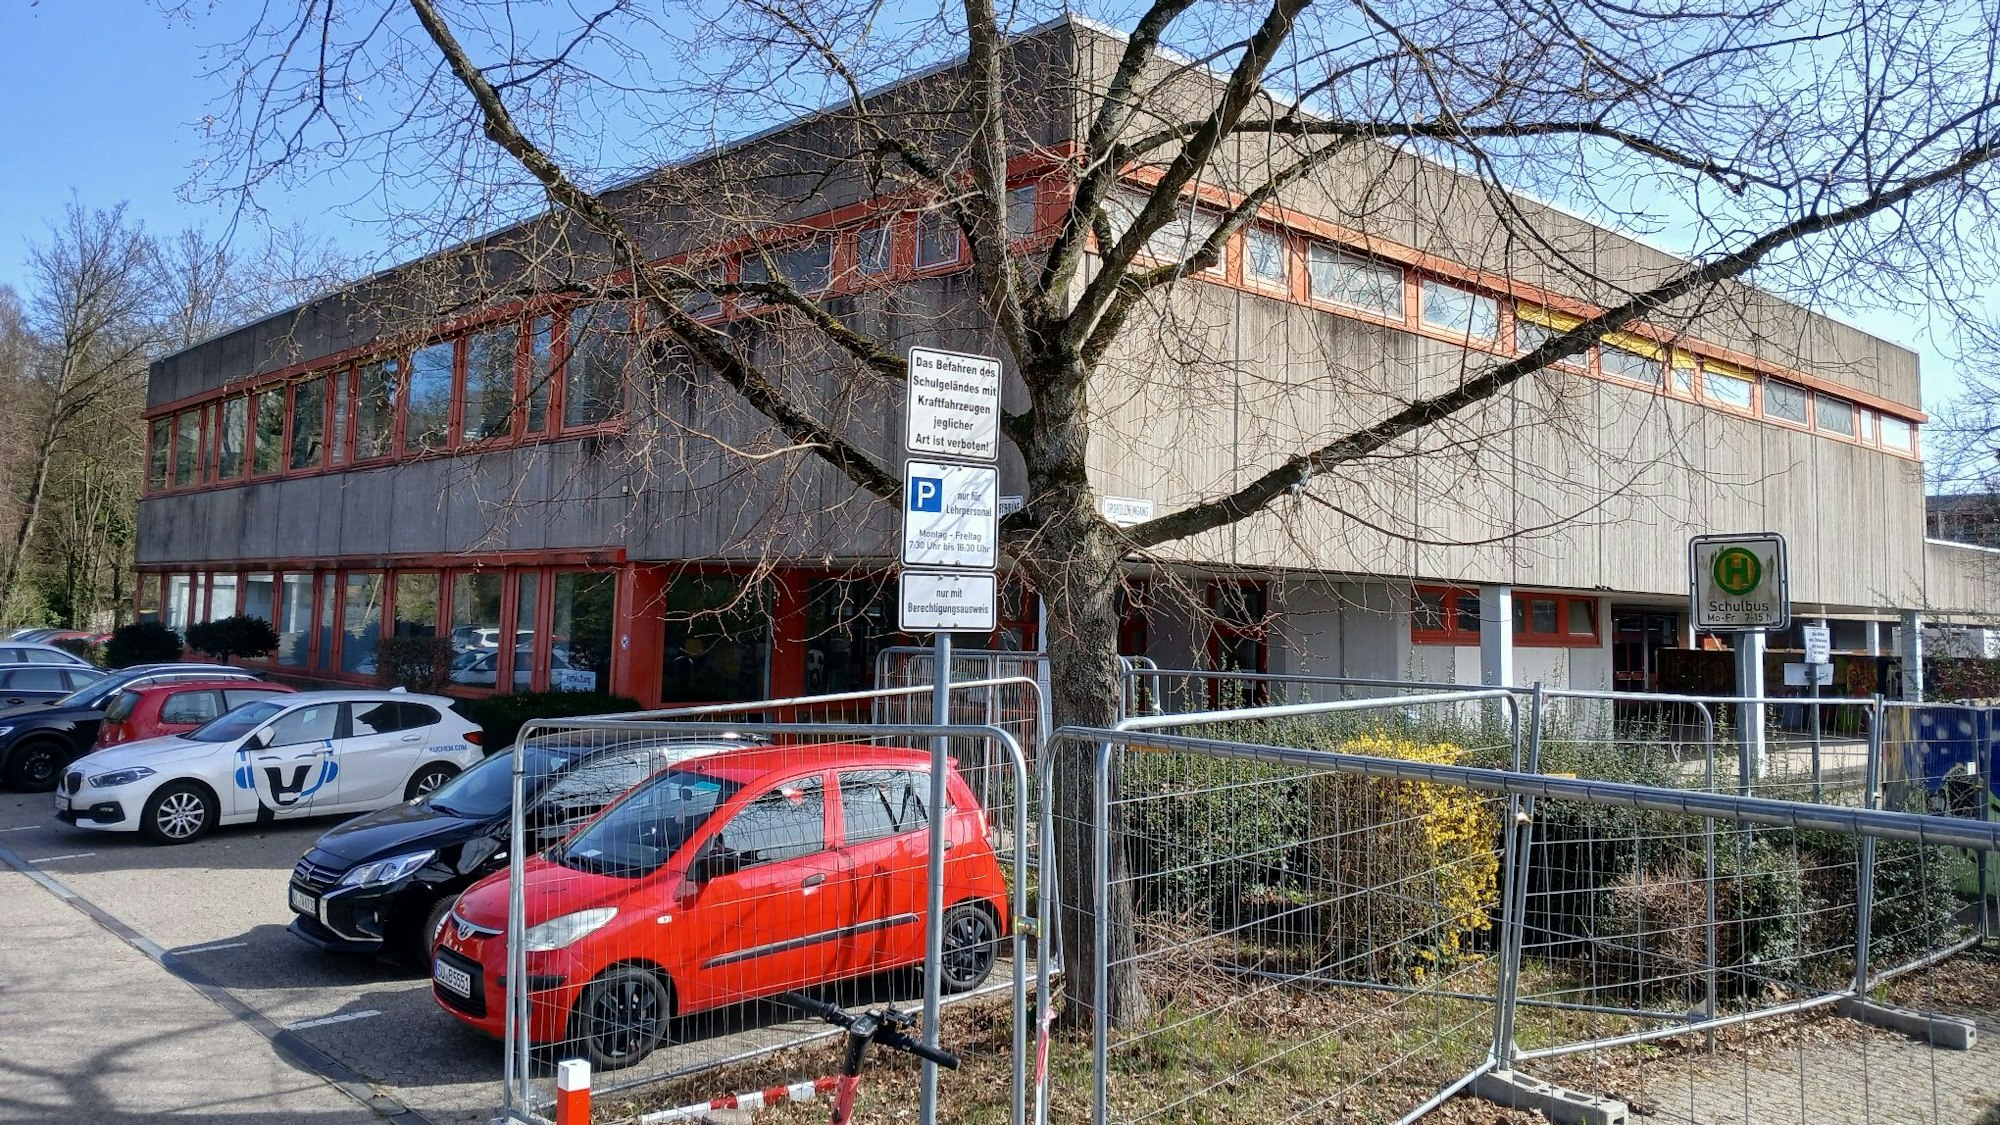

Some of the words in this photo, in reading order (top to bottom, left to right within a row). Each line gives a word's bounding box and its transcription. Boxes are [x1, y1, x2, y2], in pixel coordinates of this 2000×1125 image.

[916, 356, 933, 369] Das
[936, 359, 977, 376] Befahren
[979, 366, 996, 378] des
[913, 375, 980, 393] Schulgeländes
[982, 385, 997, 397] mit
[918, 395, 991, 415] Kraftfahrzeugen
[933, 416, 974, 431] jeglicher
[915, 433, 930, 445] Art
[933, 435, 945, 446] ist
[947, 438, 989, 452] verboten!
[917, 481, 936, 508] P
[957, 491, 970, 501] nur
[971, 491, 982, 502] für
[946, 504, 992, 517] Lehrpersonal
[919, 529, 947, 541] Montag
[955, 531, 982, 543] Freitag
[909, 540, 925, 549] 7:30
[927, 541, 941, 550] Uhr
[943, 542, 955, 551] bis
[956, 543, 975, 552] 16:30
[976, 544, 991, 553] Uhr
[1725, 557, 1749, 585] H
[936, 588, 949, 598] nur
[950, 587, 963, 599] mit
[908, 602, 989, 616] Berechtigungsausweis
[1709, 600, 1769, 612] Schulbus
[1707, 613, 1735, 622] Mo-Fr
[1744, 613, 1763, 621] 7-15
